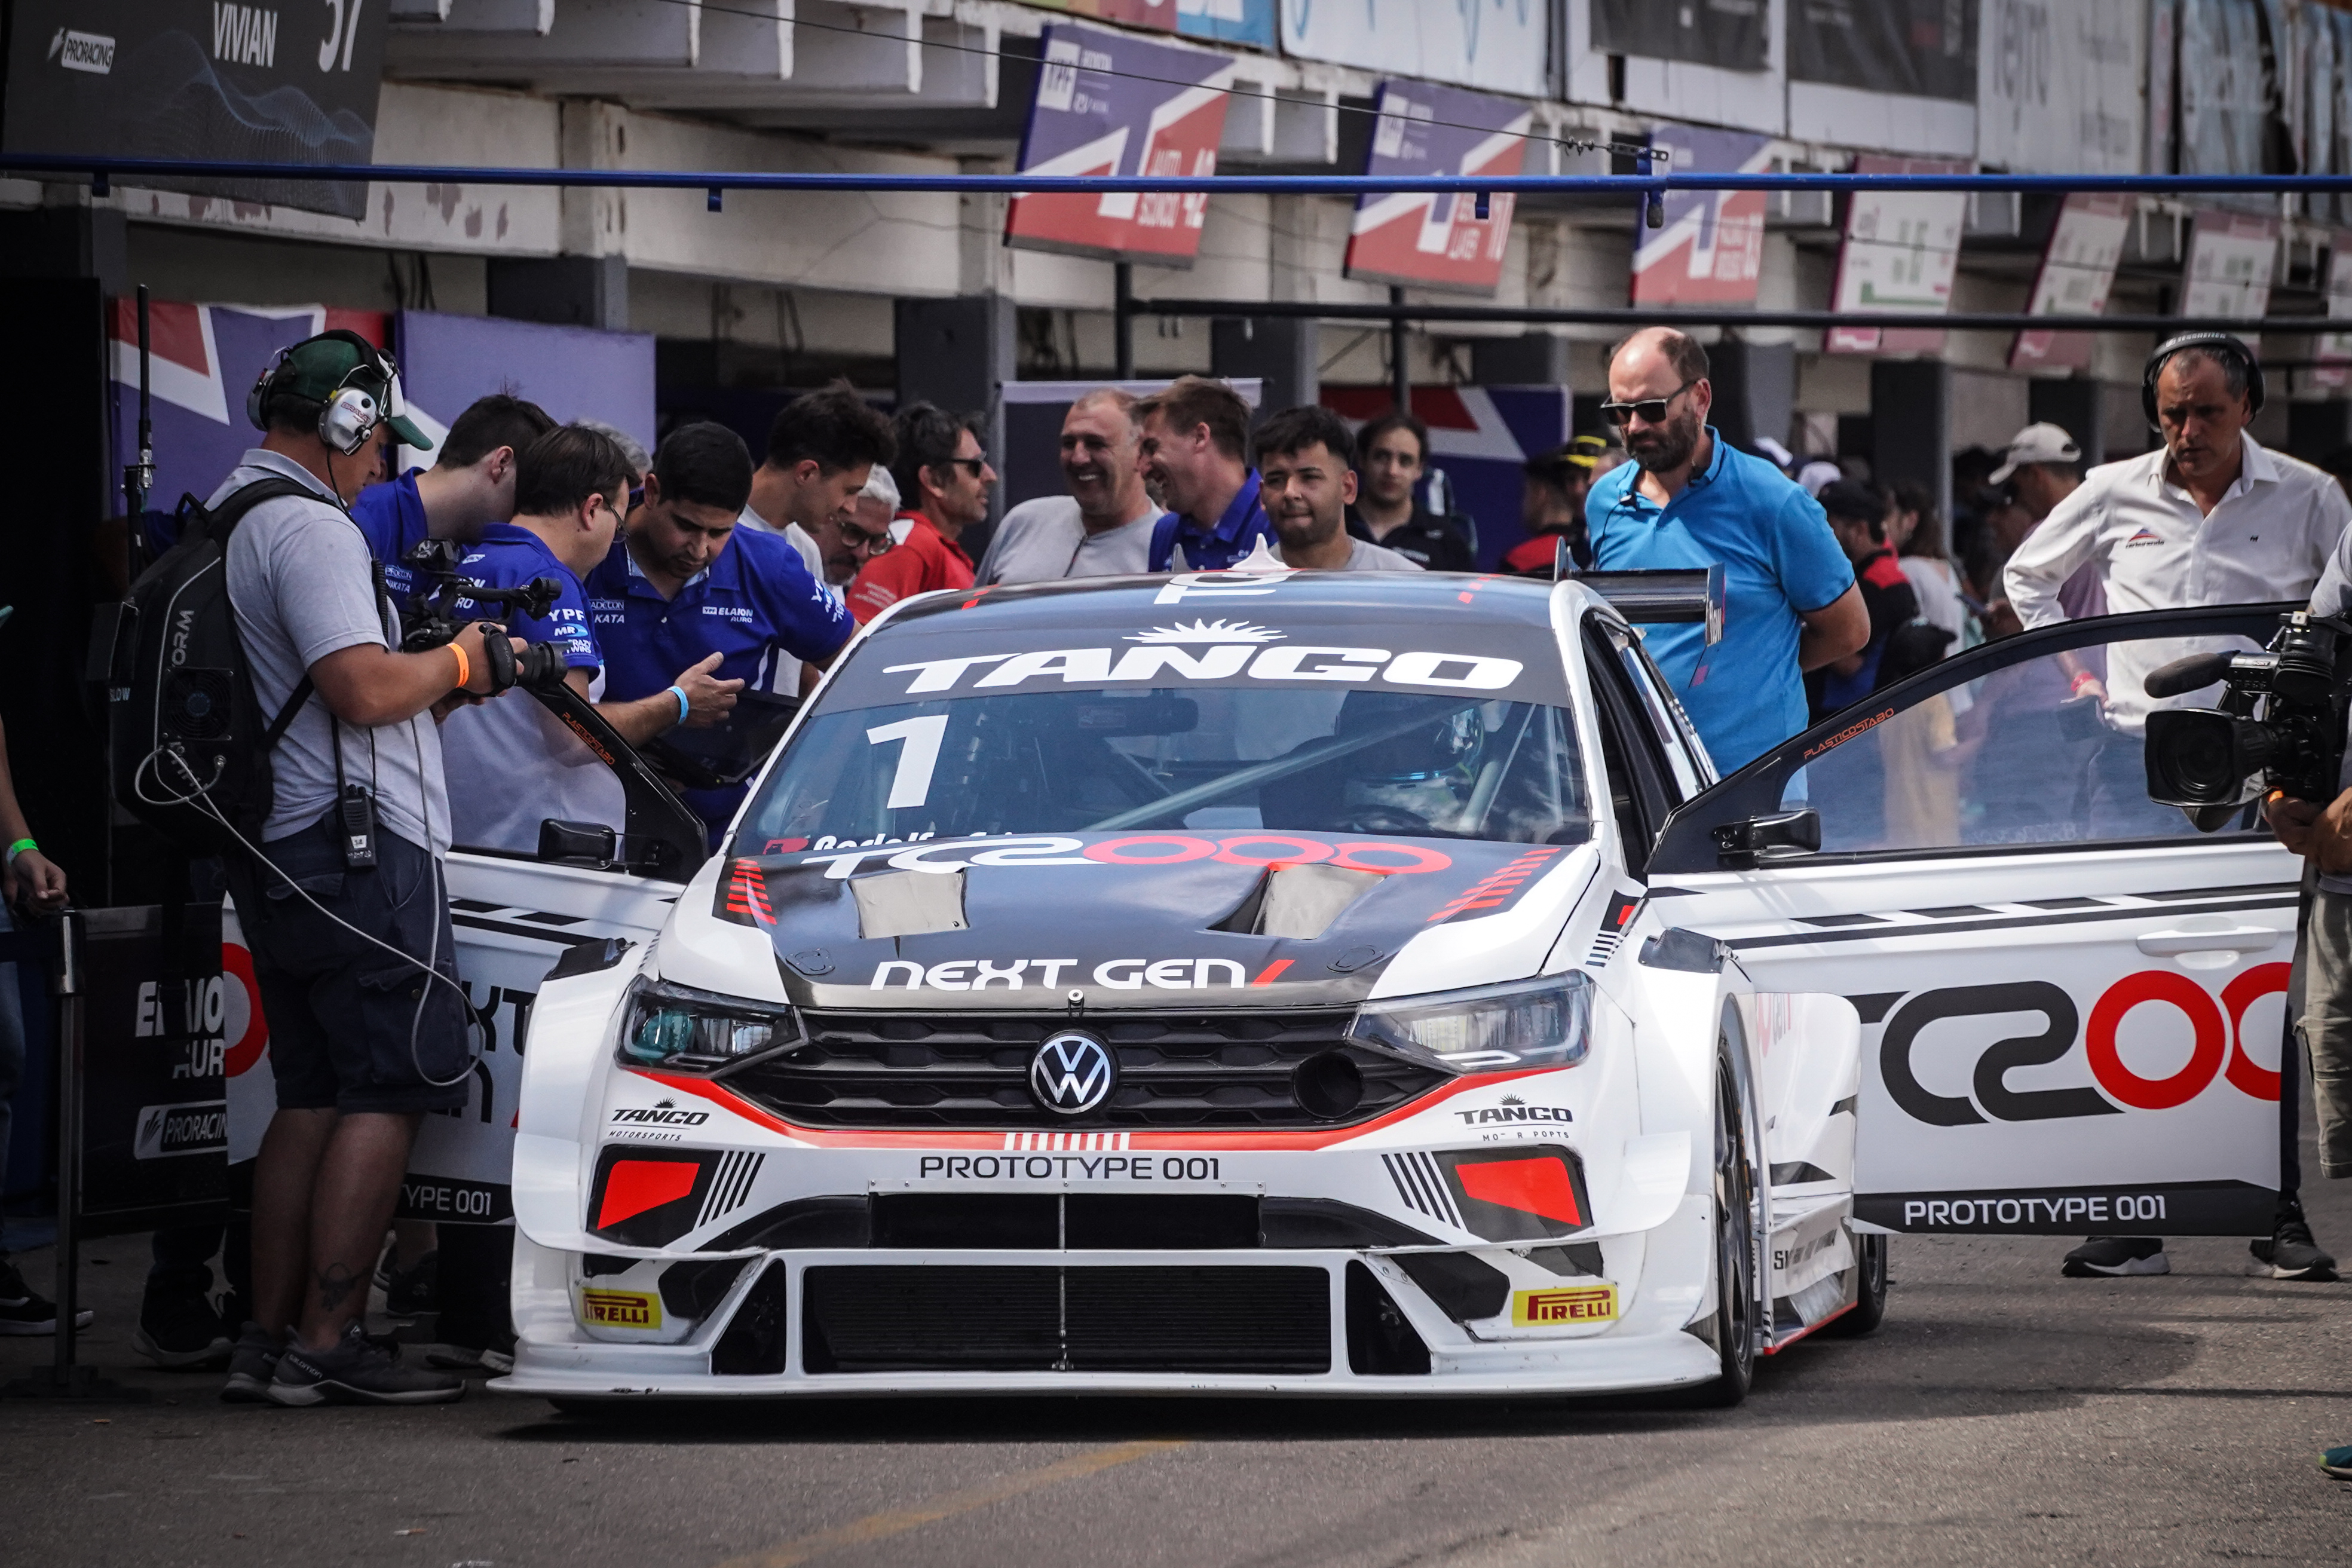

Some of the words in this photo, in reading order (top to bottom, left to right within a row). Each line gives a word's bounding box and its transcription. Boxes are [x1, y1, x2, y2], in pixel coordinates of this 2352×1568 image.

[214, 1, 278, 68] VIVIAN
[66, 37, 113, 68] PRORACING
[549, 609, 585, 621] YPF
[718, 608, 753, 617] ELAION
[883, 645, 1523, 693] TANGO
[1803, 708, 1895, 760] PLASTICOSTABO
[866, 715, 949, 808] 1
[801, 835, 1452, 879] TC2000
[870, 959, 1077, 991] NEXT
[611, 1109, 709, 1126] TANGO
[1454, 1107, 1573, 1125] TANGO
[608, 1130, 682, 1142] MOTORSPORTS
[920, 1156, 1152, 1180] PROTOTYPE
[1163, 1157, 1220, 1180] 001
[456, 1189, 491, 1216] 001
[1904, 1196, 2108, 1226] PROTOTYPE
[2115, 1195, 2166, 1220] 001
[584, 1294, 650, 1325] PIRELLI
[1527, 1290, 1611, 1321] PIRELLI
